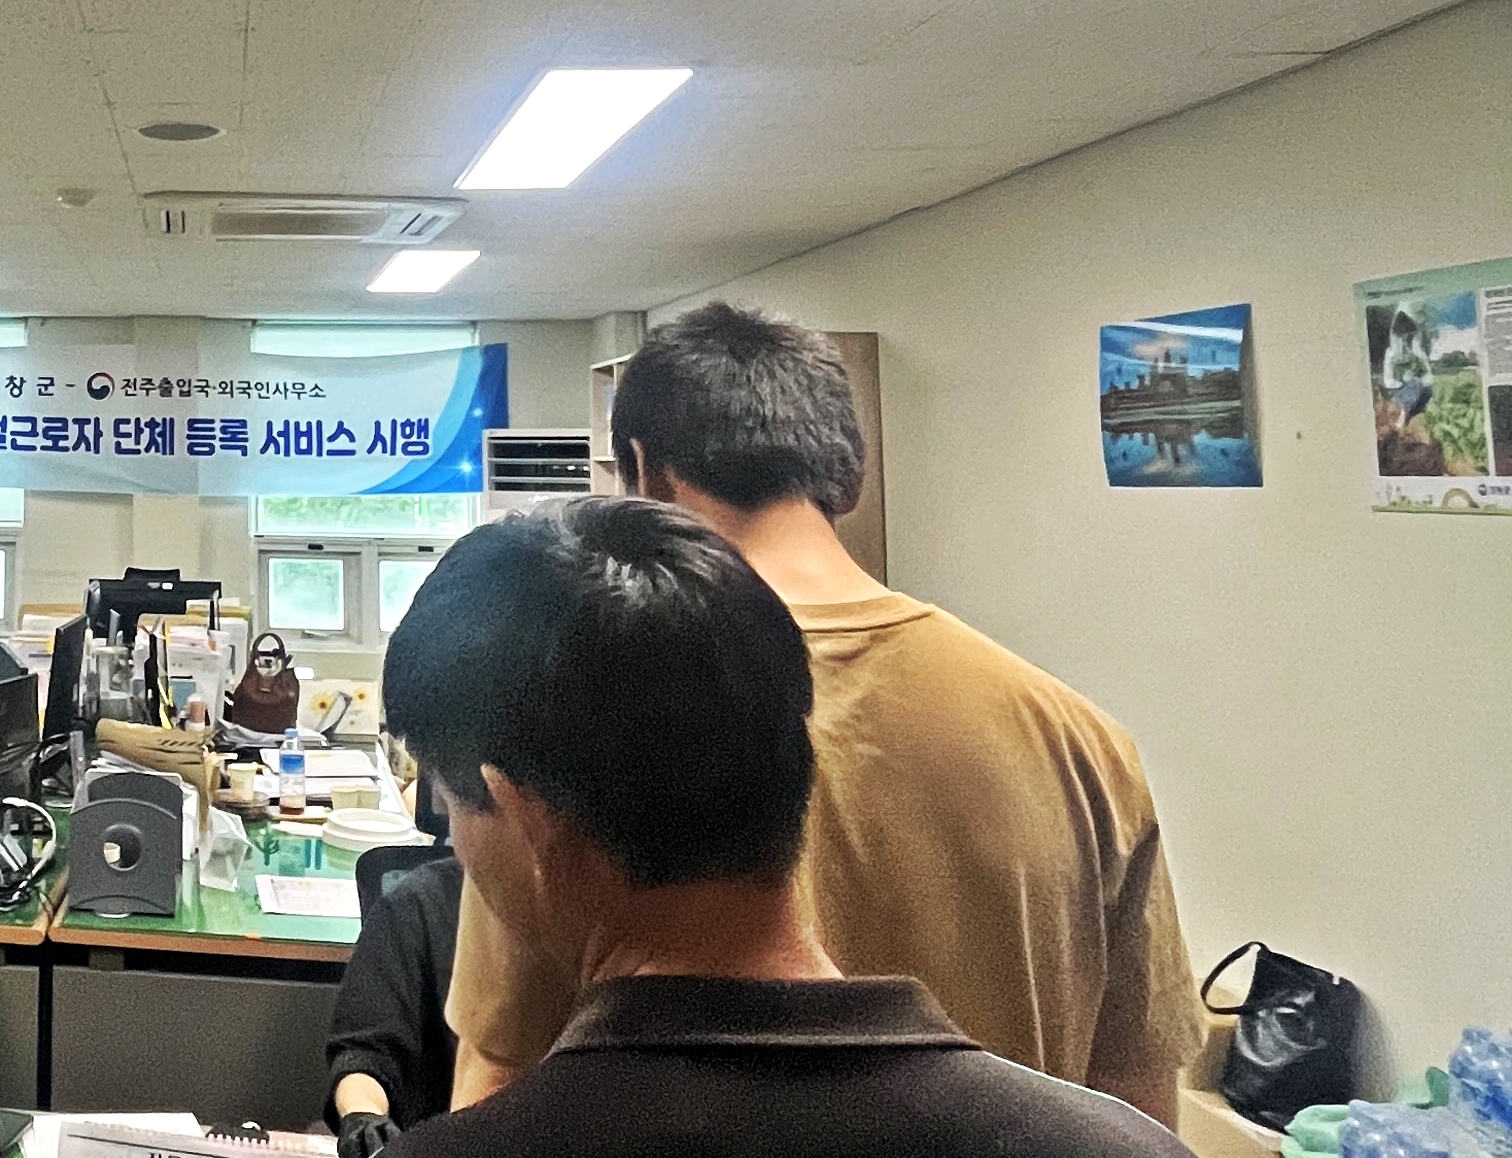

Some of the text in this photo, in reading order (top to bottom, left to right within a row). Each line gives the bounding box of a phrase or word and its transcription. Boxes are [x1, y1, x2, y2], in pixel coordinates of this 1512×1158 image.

[113, 416, 176, 456] 단체
[185, 417, 250, 458] 등록
[259, 418, 357, 458] 서비스
[366, 417, 431, 457] 시행
